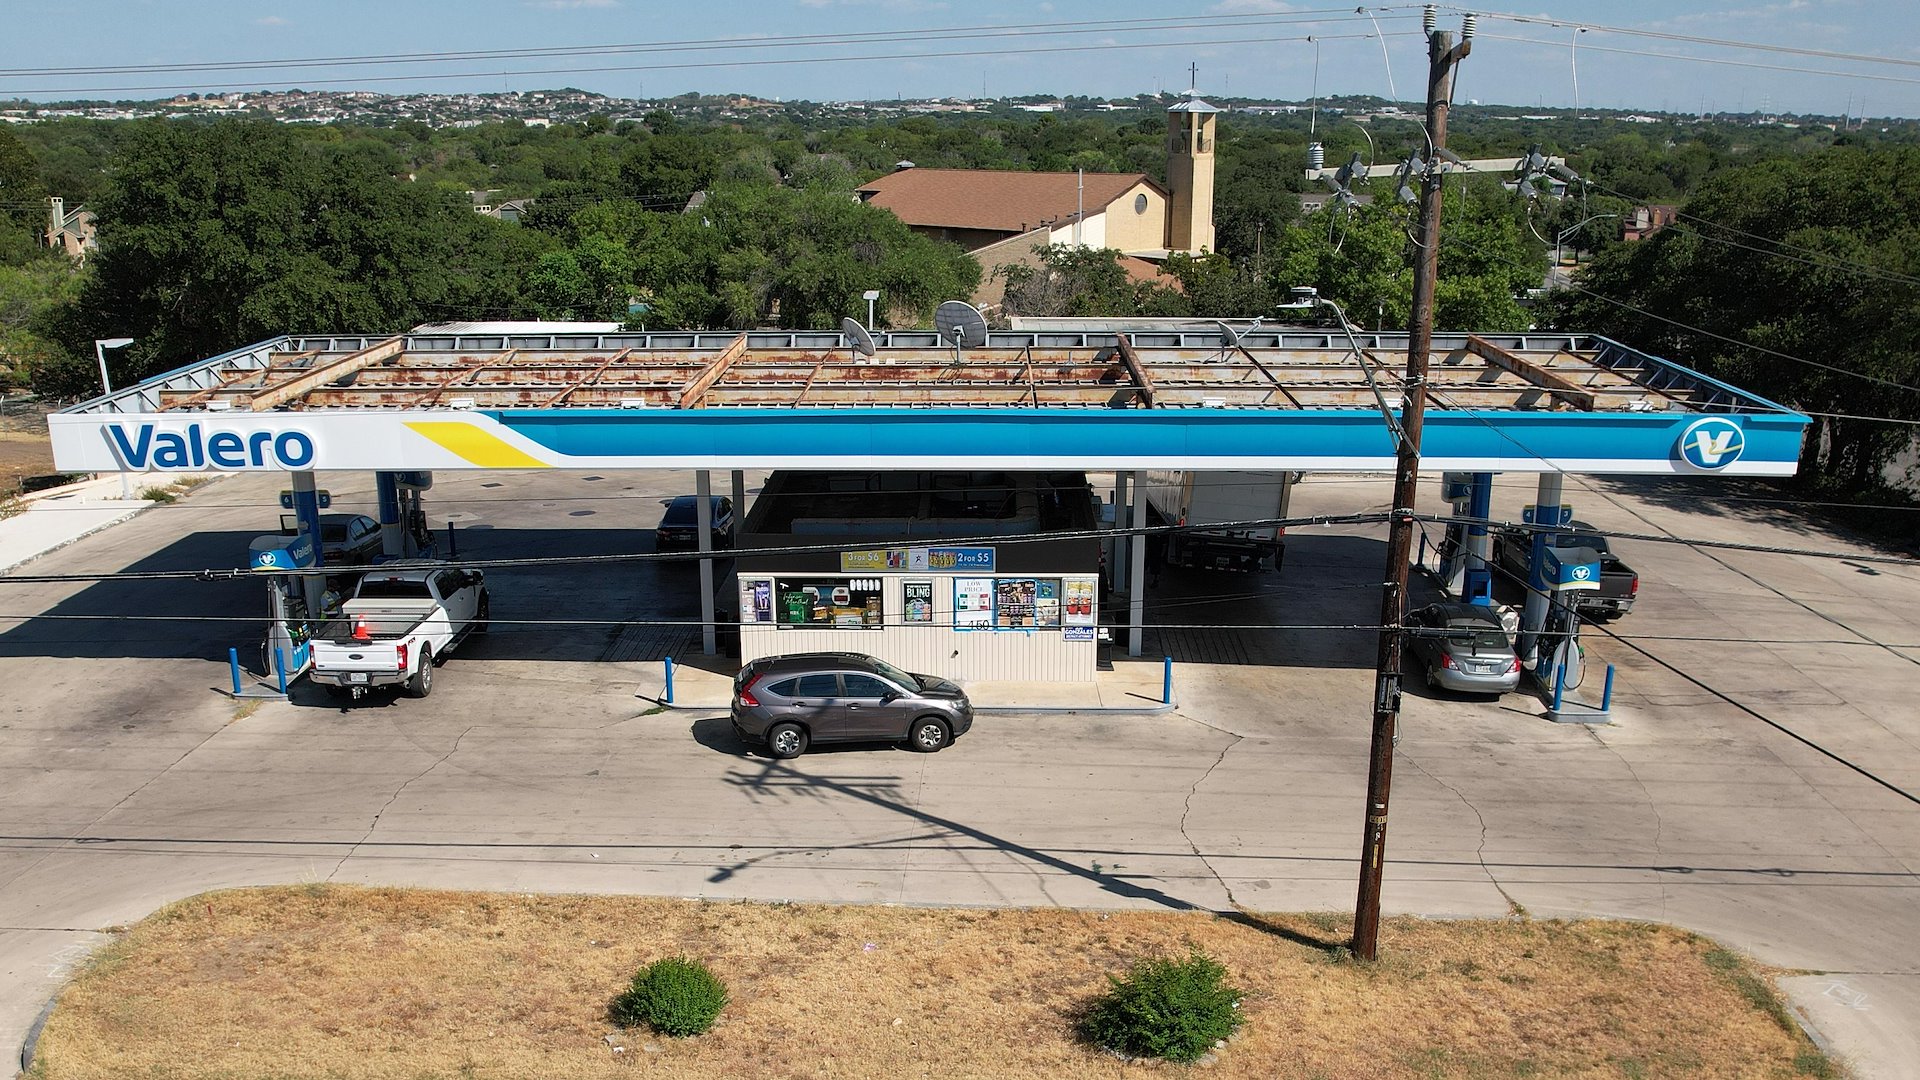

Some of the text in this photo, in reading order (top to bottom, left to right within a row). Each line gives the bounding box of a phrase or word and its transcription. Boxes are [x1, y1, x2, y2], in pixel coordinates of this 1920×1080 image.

[109, 423, 314, 468] Valero
[848, 552, 853, 561] 3
[957, 553, 963, 562] 2
[977, 553, 989, 562] $5
[907, 588, 930, 598] BLING
